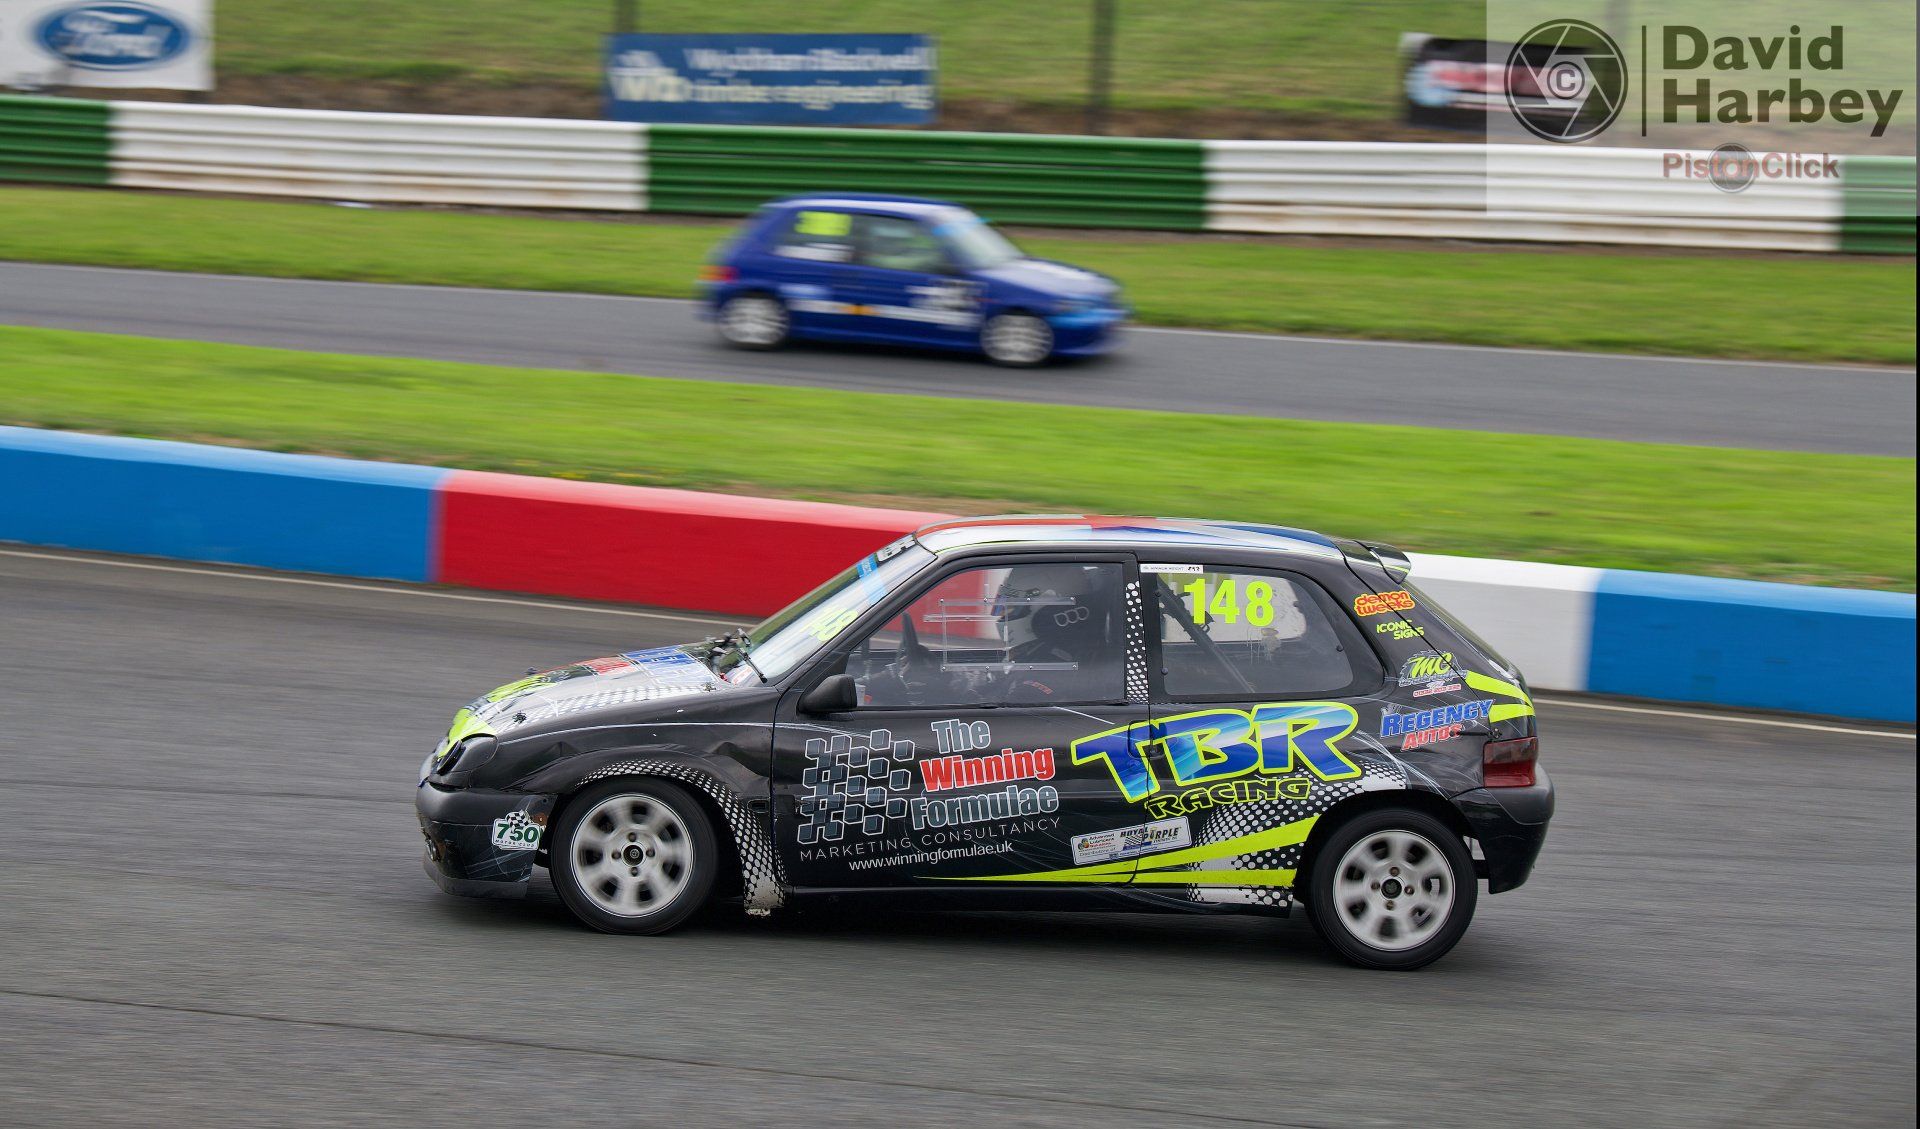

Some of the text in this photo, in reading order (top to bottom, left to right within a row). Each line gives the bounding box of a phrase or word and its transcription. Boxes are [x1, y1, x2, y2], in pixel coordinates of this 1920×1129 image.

[1183, 578, 1274, 627] 148
[1355, 600, 1415, 615] tweeks
[1356, 591, 1409, 606] demon
[1376, 619, 1412, 634] ICONIC
[1393, 626, 1425, 640] SIGNS
[1407, 652, 1453, 679] MC
[1381, 699, 1495, 737] REGENCY
[931, 718, 992, 755] The
[1070, 701, 1362, 803] TBR
[1400, 723, 1464, 752] AUTOS
[919, 747, 1056, 793] Winning
[910, 784, 1060, 831] Formulae
[1145, 777, 1311, 820] RACING
[497, 823, 539, 843] 750
[800, 816, 1061, 863] MARKETING CONSULTANCY
[1120, 826, 1149, 838] ROYAL
[849, 840, 1015, 872] www.winningformulae.uk
